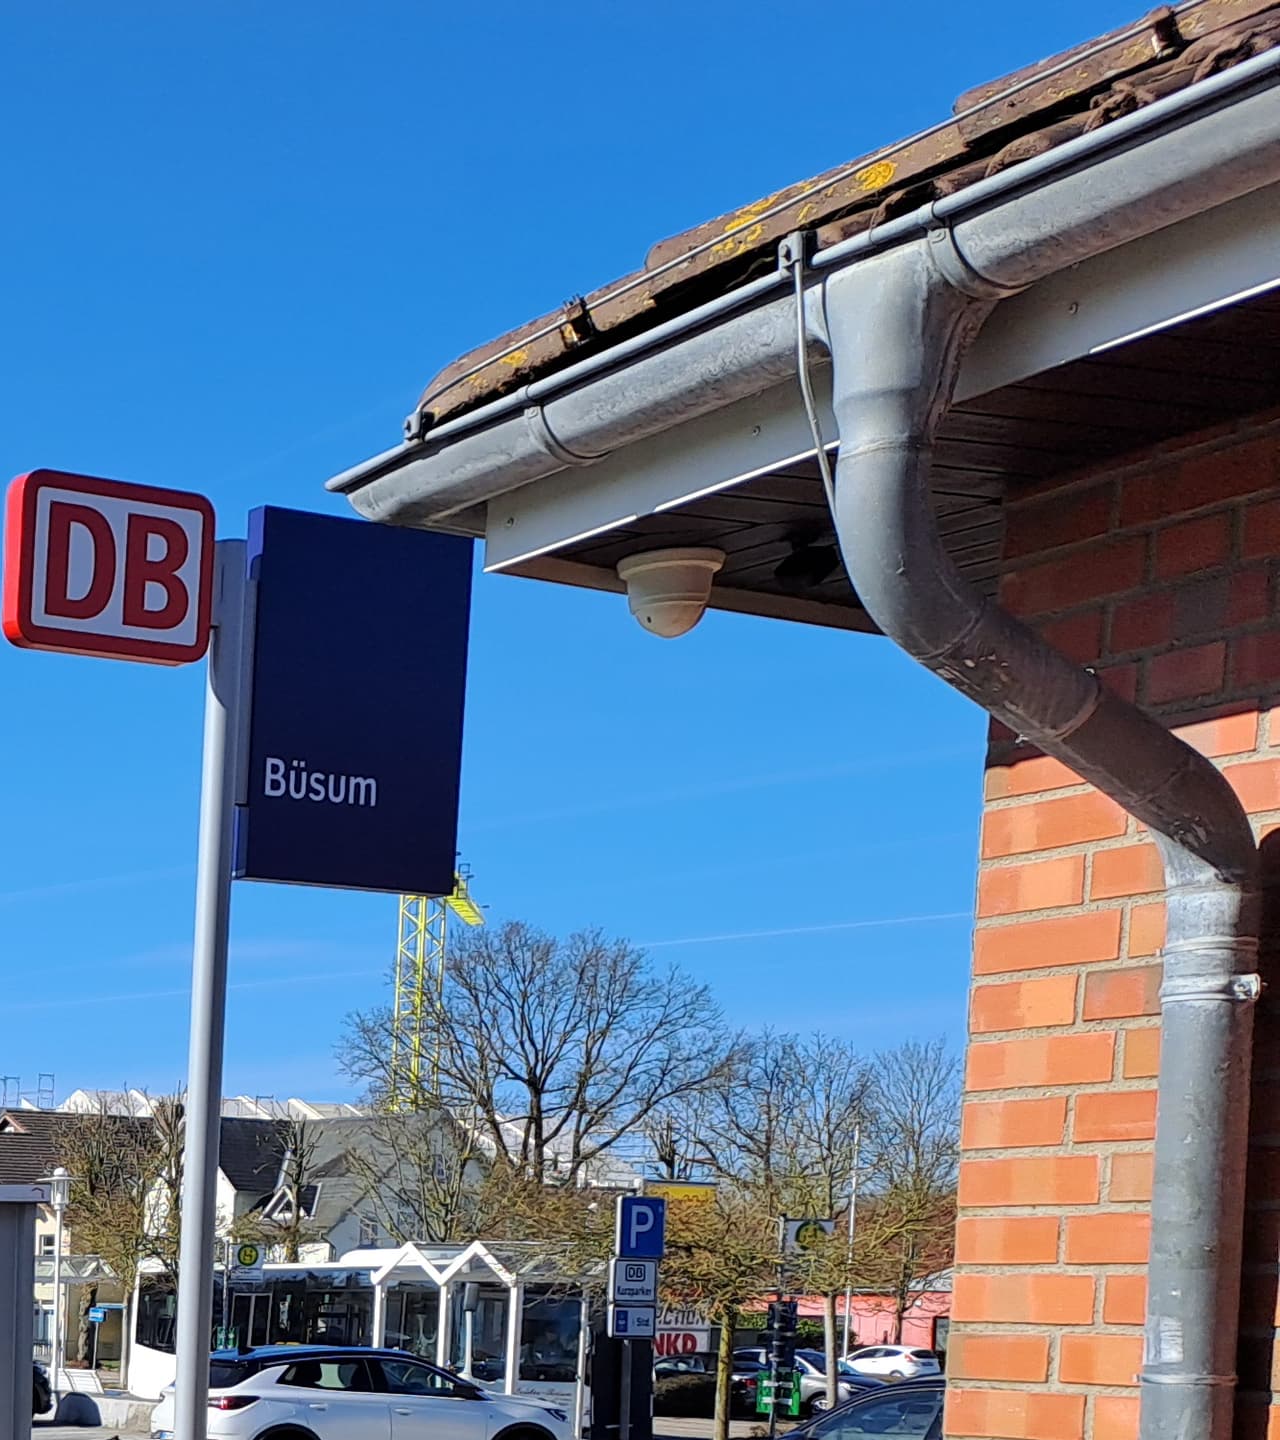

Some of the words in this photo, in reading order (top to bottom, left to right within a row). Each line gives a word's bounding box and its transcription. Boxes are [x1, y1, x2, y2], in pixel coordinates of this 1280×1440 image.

[44, 500, 190, 630] DB
[264, 757, 377, 807] Büsum
[630, 1205, 654, 1249] P
[629, 1267, 643, 1279] DB
[654, 1332, 697, 1356] NKD
